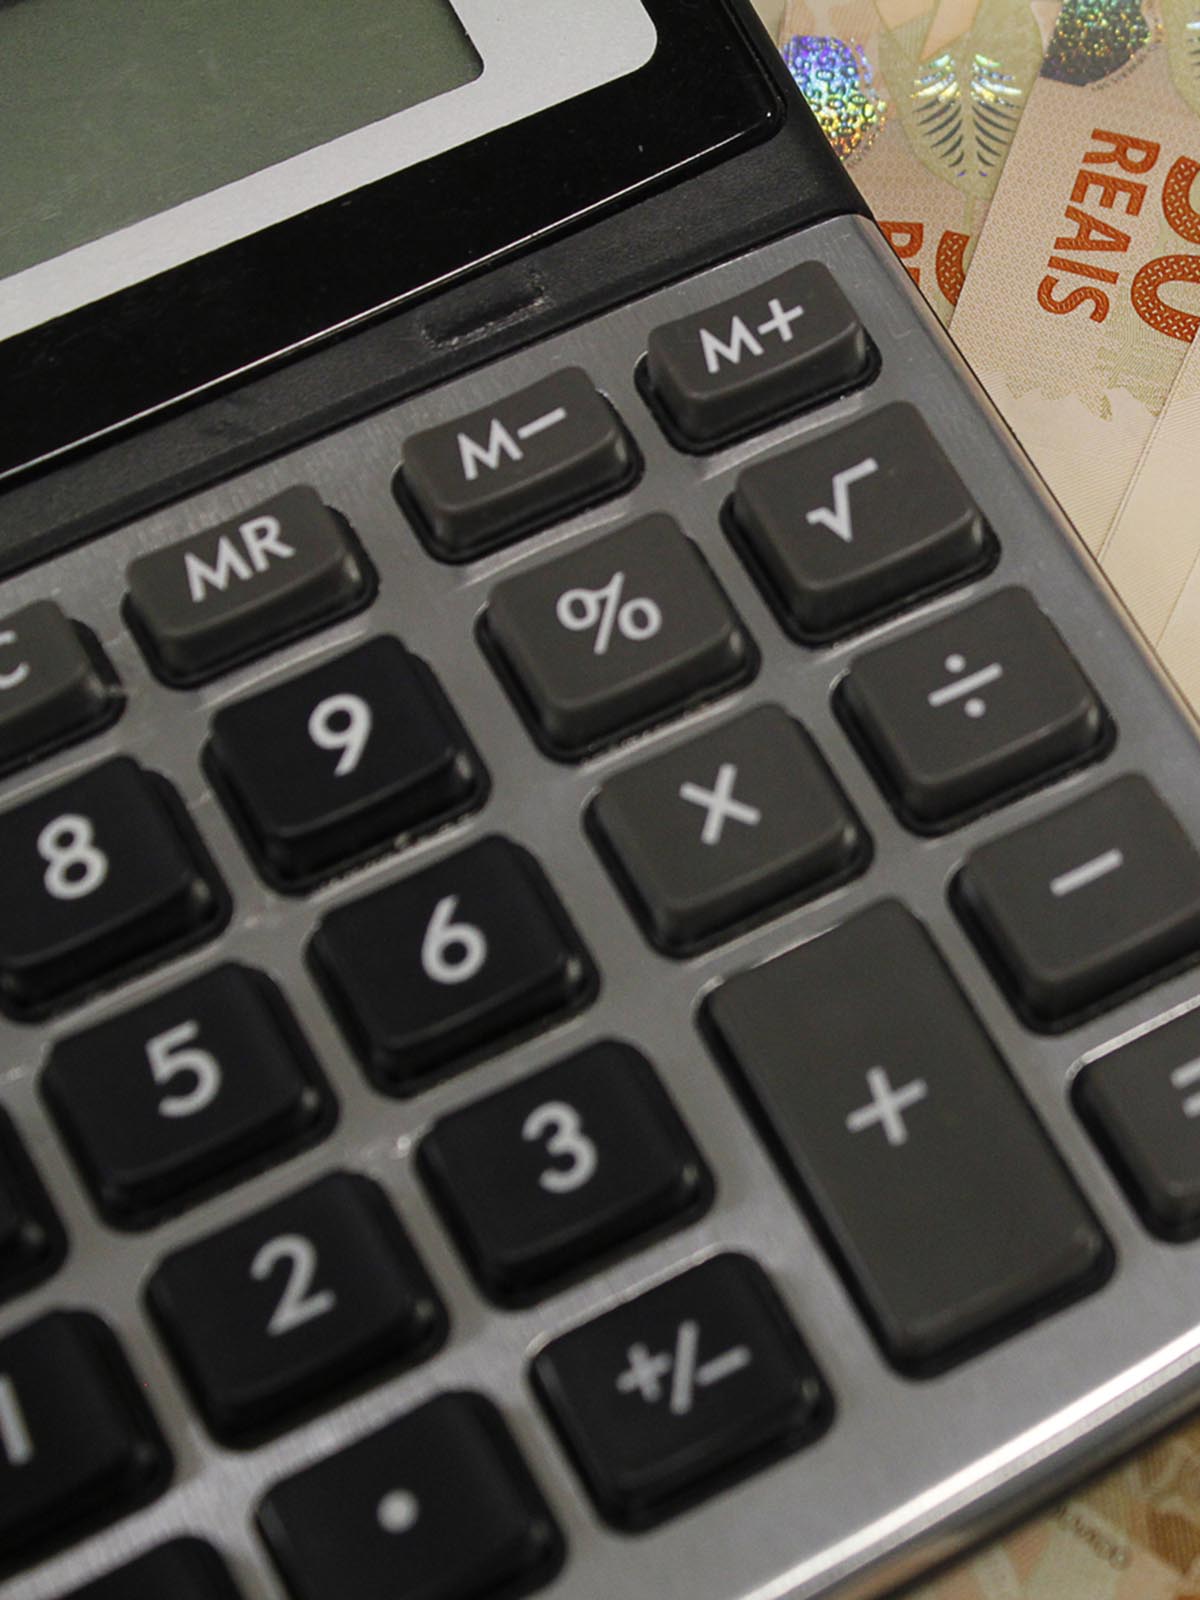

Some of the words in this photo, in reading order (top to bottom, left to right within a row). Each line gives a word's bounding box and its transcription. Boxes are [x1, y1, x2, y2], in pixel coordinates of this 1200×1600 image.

[1037, 128, 1161, 324] REAIS
[698, 298, 805, 375] M+
[456, 405, 567, 482] M-
[181, 514, 295, 603] MR
[556, 570, 663, 656] %
[308, 693, 372, 776] 9
[37, 813, 108, 900] 8
[421, 895, 487, 984] 6
[146, 1021, 220, 1117] 5
[522, 1101, 597, 1193] 3
[251, 1234, 335, 1336] 2
